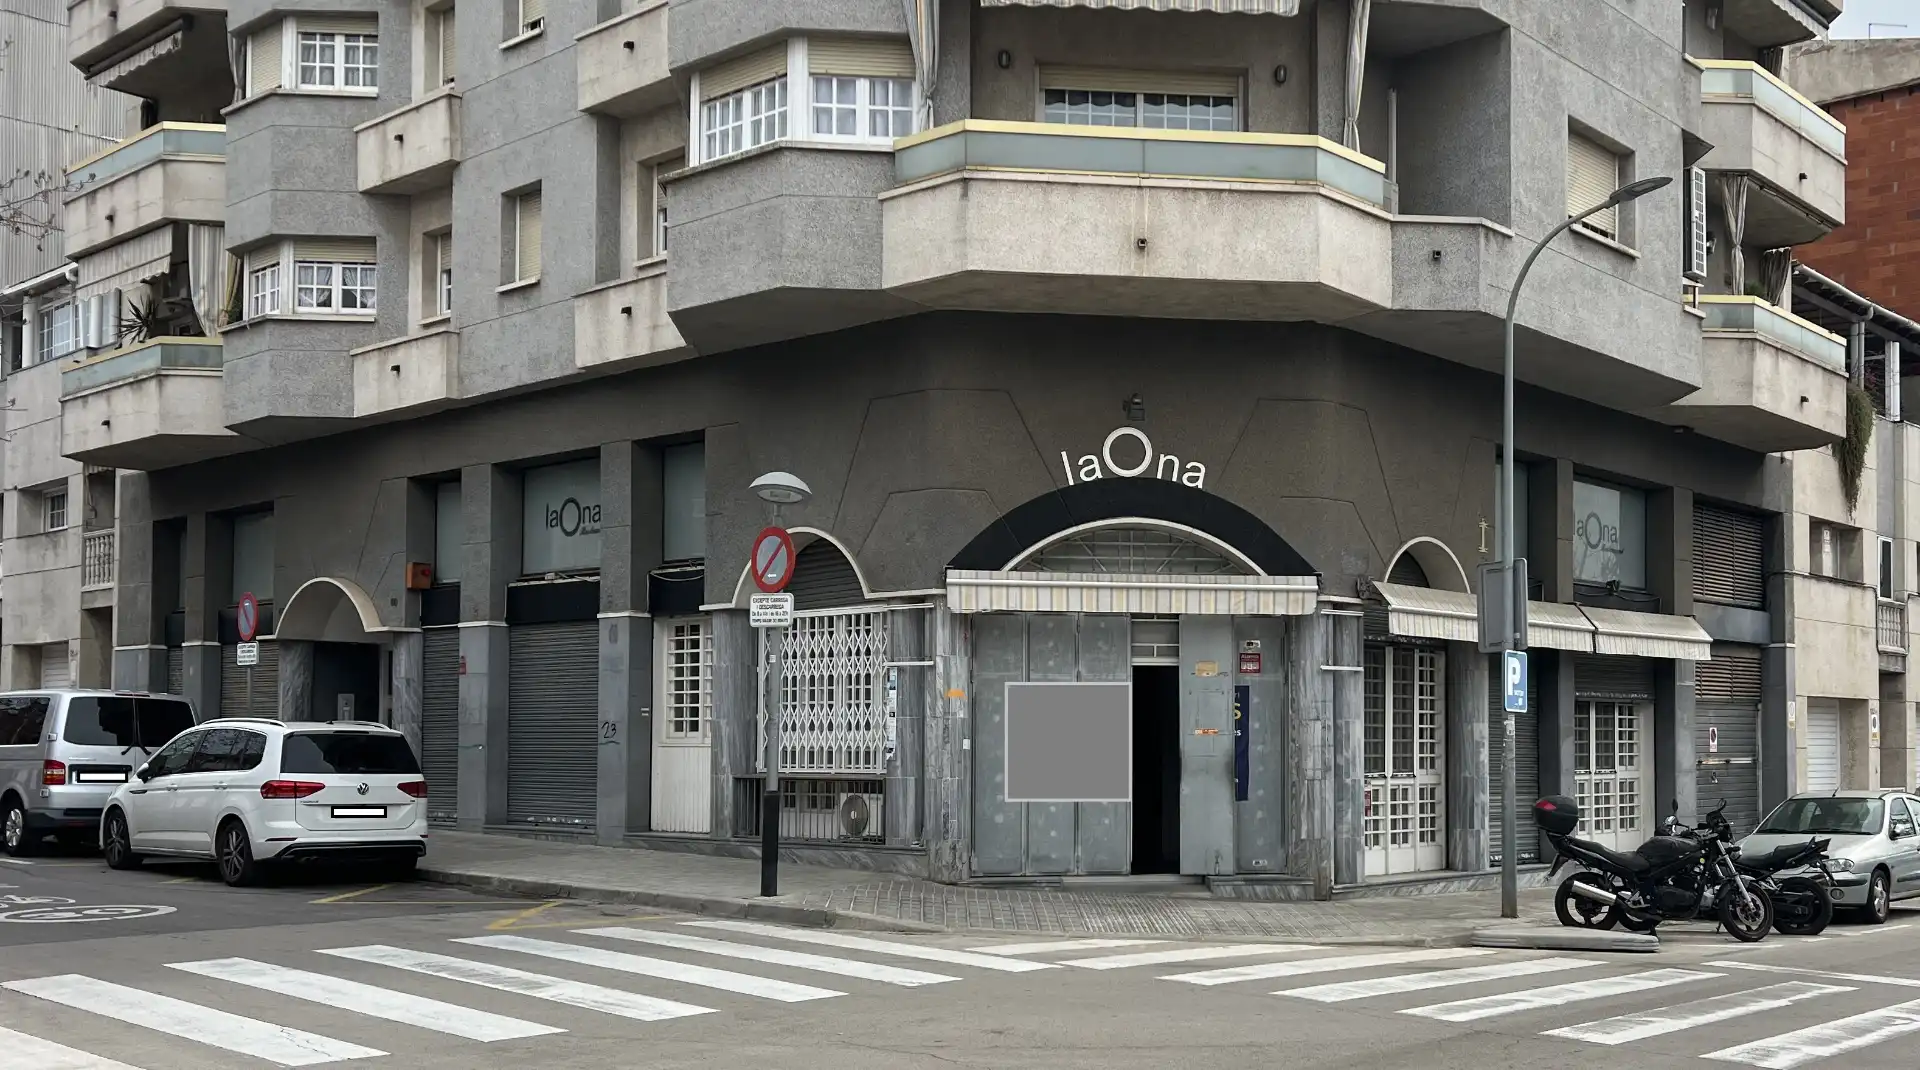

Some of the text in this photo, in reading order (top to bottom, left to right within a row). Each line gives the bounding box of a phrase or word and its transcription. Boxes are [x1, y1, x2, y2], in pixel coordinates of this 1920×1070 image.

[1060, 426, 1206, 489] laOna
[545, 497, 601, 537] laOna
[1507, 656, 1521, 696] P
